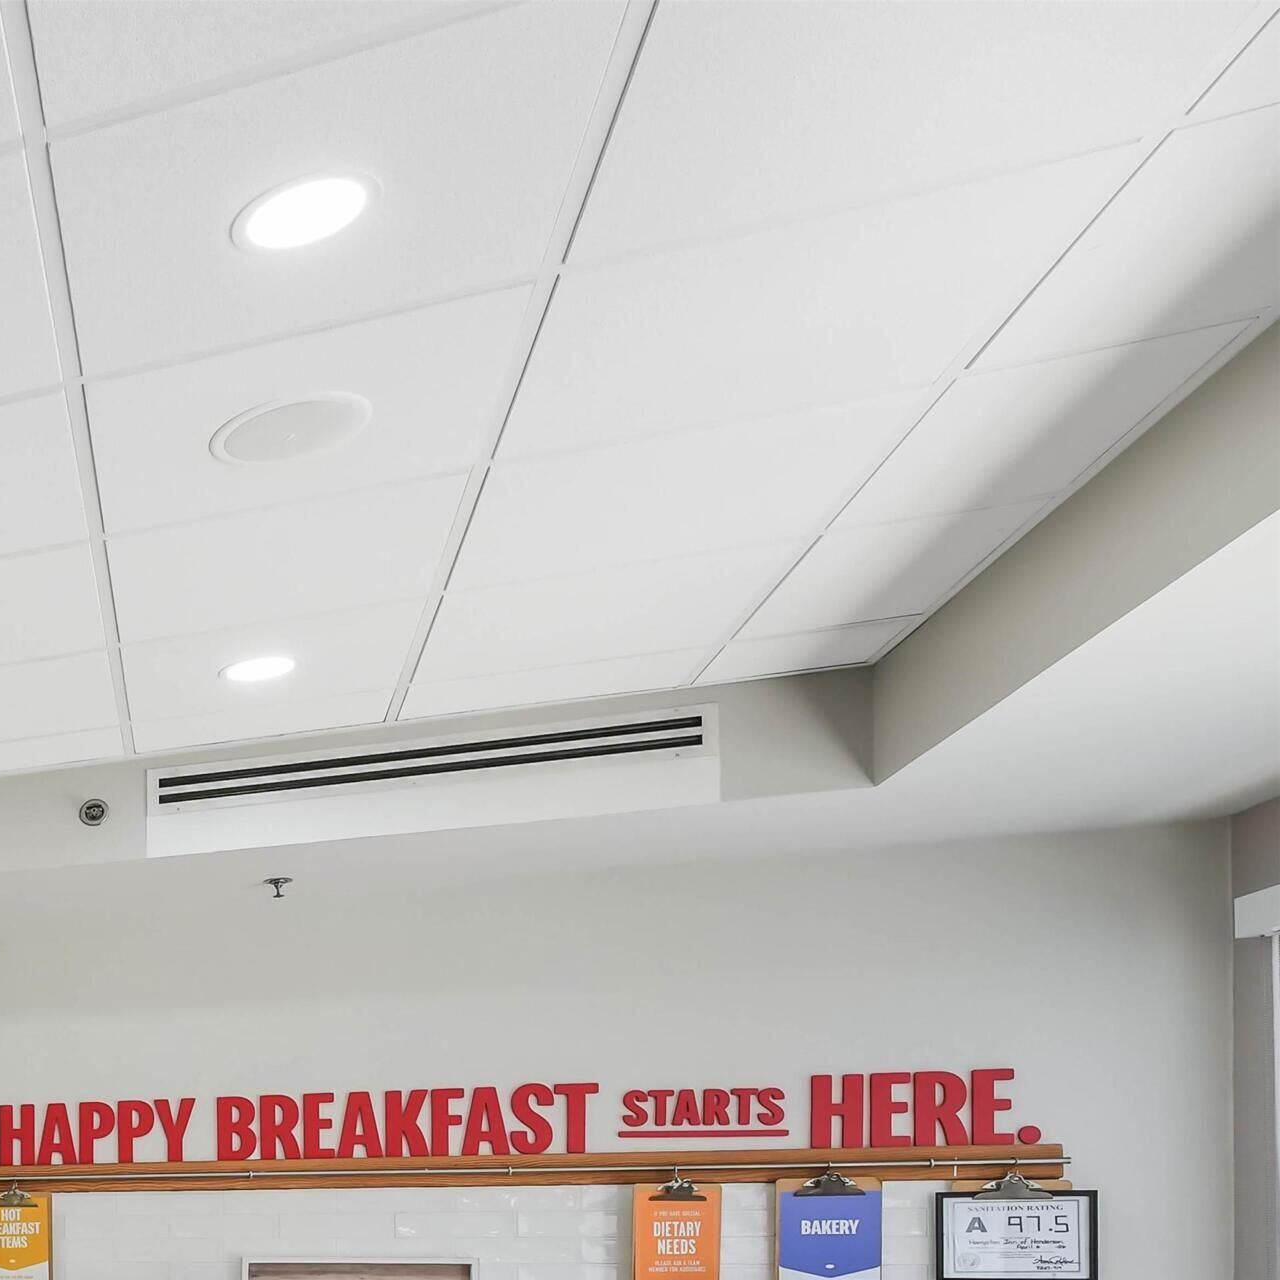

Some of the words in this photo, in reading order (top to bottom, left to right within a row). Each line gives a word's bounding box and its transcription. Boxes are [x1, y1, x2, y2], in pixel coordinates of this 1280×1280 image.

[216, 1082, 599, 1162] BREAKFAST
[622, 1087, 785, 1127] STARTS
[810, 1068, 1042, 1149] HERE.
[0, 1208, 22, 1221] HOT
[653, 1221, 701, 1237] DIETARY
[800, 1220, 859, 1235] BAKERY
[966, 1217, 988, 1233] A
[1008, 1215, 1069, 1233] 97.5
[657, 1240, 696, 1255] NEEDS
